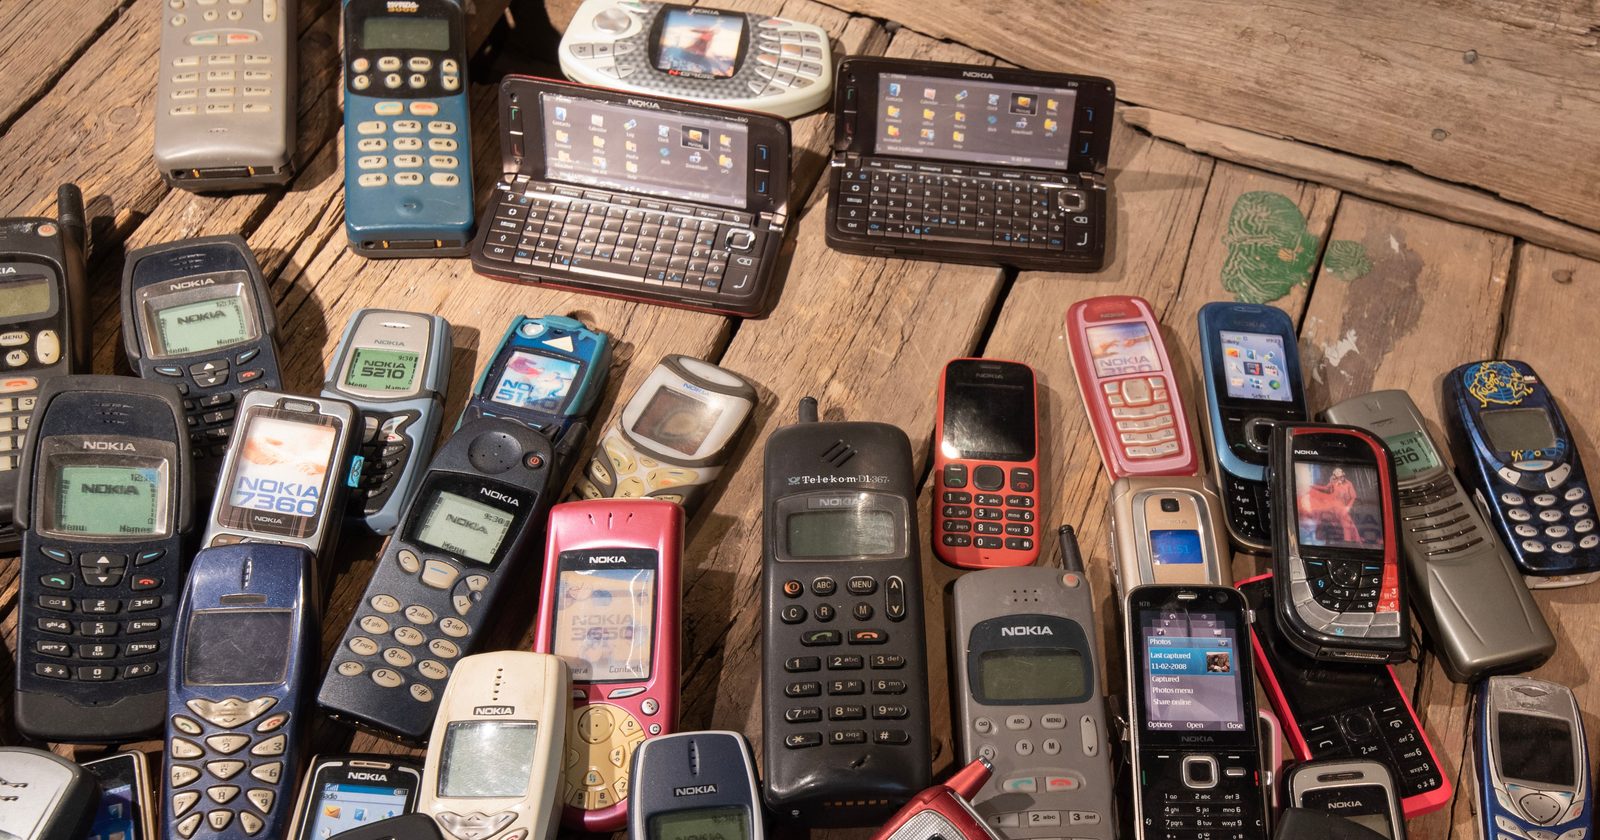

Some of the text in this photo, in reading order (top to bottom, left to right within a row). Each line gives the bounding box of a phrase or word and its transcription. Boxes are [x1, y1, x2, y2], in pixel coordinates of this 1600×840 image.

[962, 71, 994, 79] NOKIA
[627, 99, 660, 109] NOKIA
[170, 278, 215, 291] NOKIA
[177, 310, 227, 326] NOKIA
[364, 360, 406, 369] NOKIA
[1100, 355, 1150, 367] NOKIA
[361, 367, 405, 379] 5210
[83, 441, 136, 452] NOKIA
[1395, 452, 1420, 466] 310
[81, 483, 140, 495] NOKIA
[238, 475, 319, 499] NOKIA
[480, 487, 520, 507] NOKIA
[819, 498, 862, 506] NOKIA
[236, 490, 317, 516] 7360
[254, 515, 282, 525] NOKIA
[445, 513, 489, 535] NOKIA
[589, 555, 627, 564] NOKIA
[816, 581, 831, 589] ABC
[790, 606, 867, 618] C R M
[571, 614, 634, 626] NOKIA
[571, 626, 634, 641] 3650
[1001, 626, 1053, 636] NOKIA
[834, 658, 842, 666] 2
[877, 656, 885, 664] 3
[792, 683, 815, 693] 4 ghi
[835, 682, 842, 691] 5
[878, 681, 886, 690] 6
[475, 706, 513, 715] NOKIA
[793, 709, 802, 718] 7
[835, 707, 844, 715] 8
[878, 706, 886, 715] 9
[835, 732, 844, 741] 0
[347, 772, 387, 781] NOKIA
[675, 784, 717, 796] NOKIA
[1327, 800, 1363, 809] NOKIA
